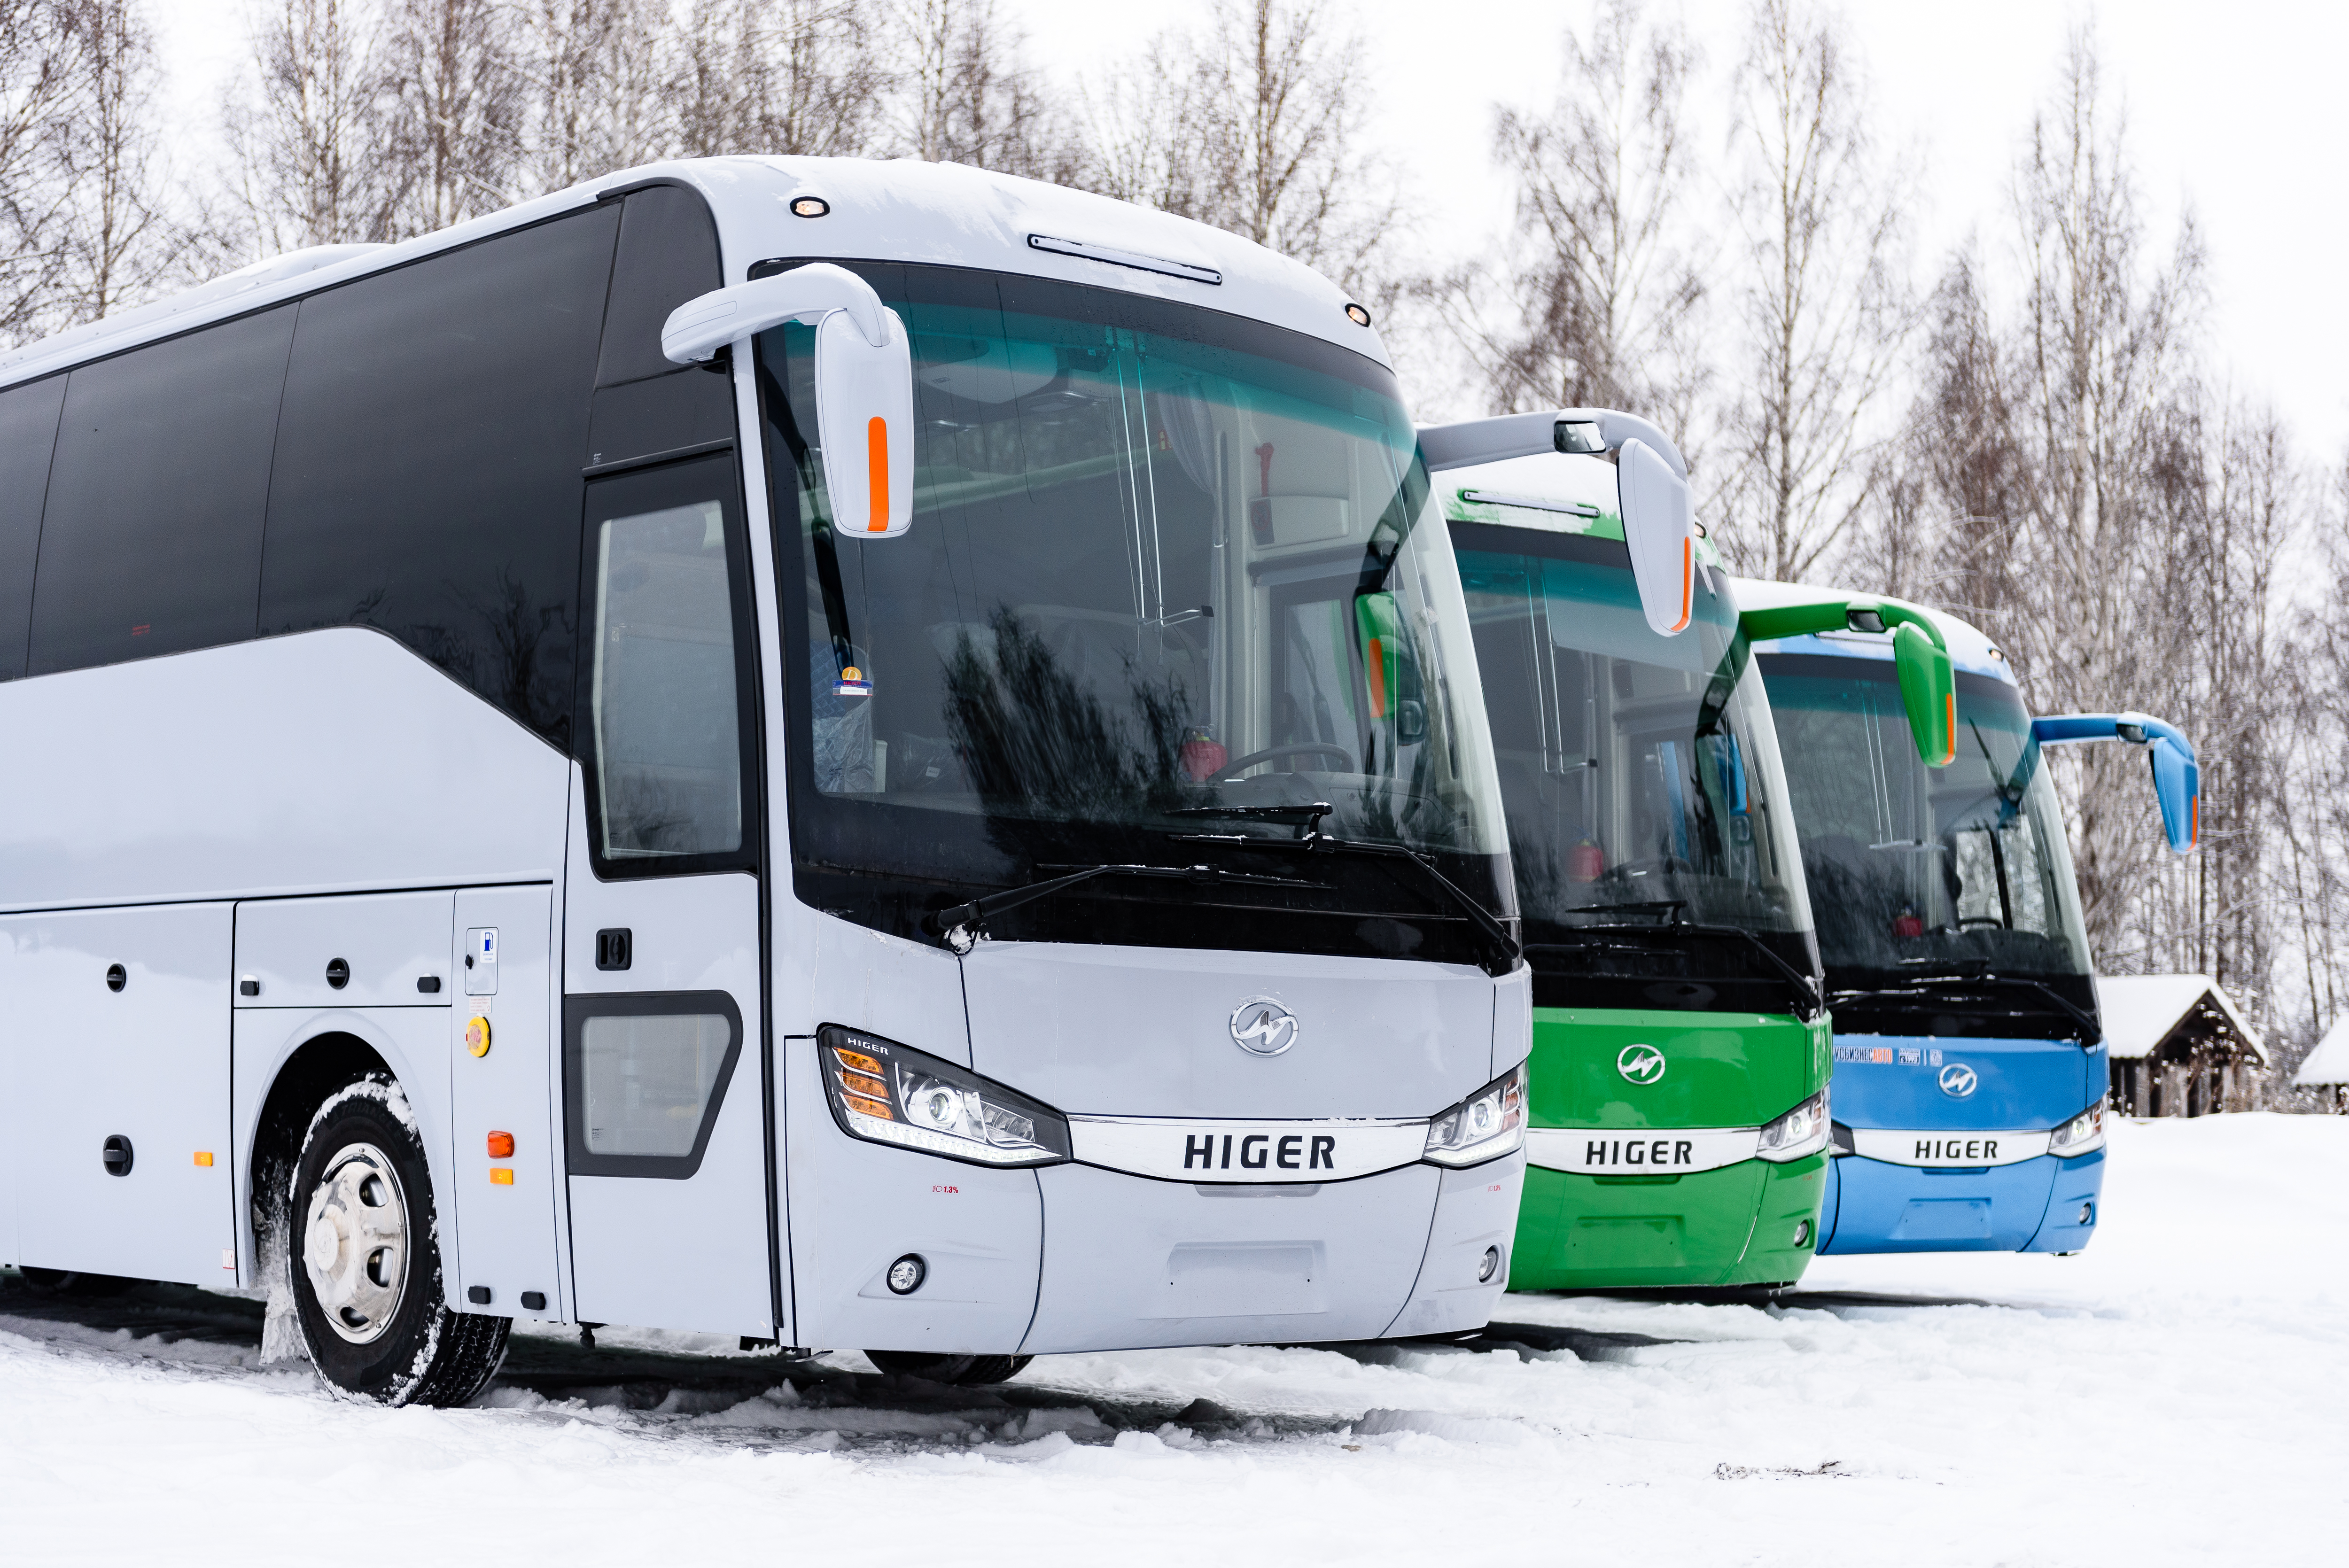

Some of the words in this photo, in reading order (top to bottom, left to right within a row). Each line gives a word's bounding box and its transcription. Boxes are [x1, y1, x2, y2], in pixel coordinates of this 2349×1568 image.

[848, 1037, 889, 1056] HIGER
[1834, 1046, 1892, 1063] УСБИЗНЕСАВТО
[1183, 1135, 1335, 1169] HIGER
[1586, 1141, 1692, 1165] HIGER
[1915, 1141, 1998, 1159] HIGER
